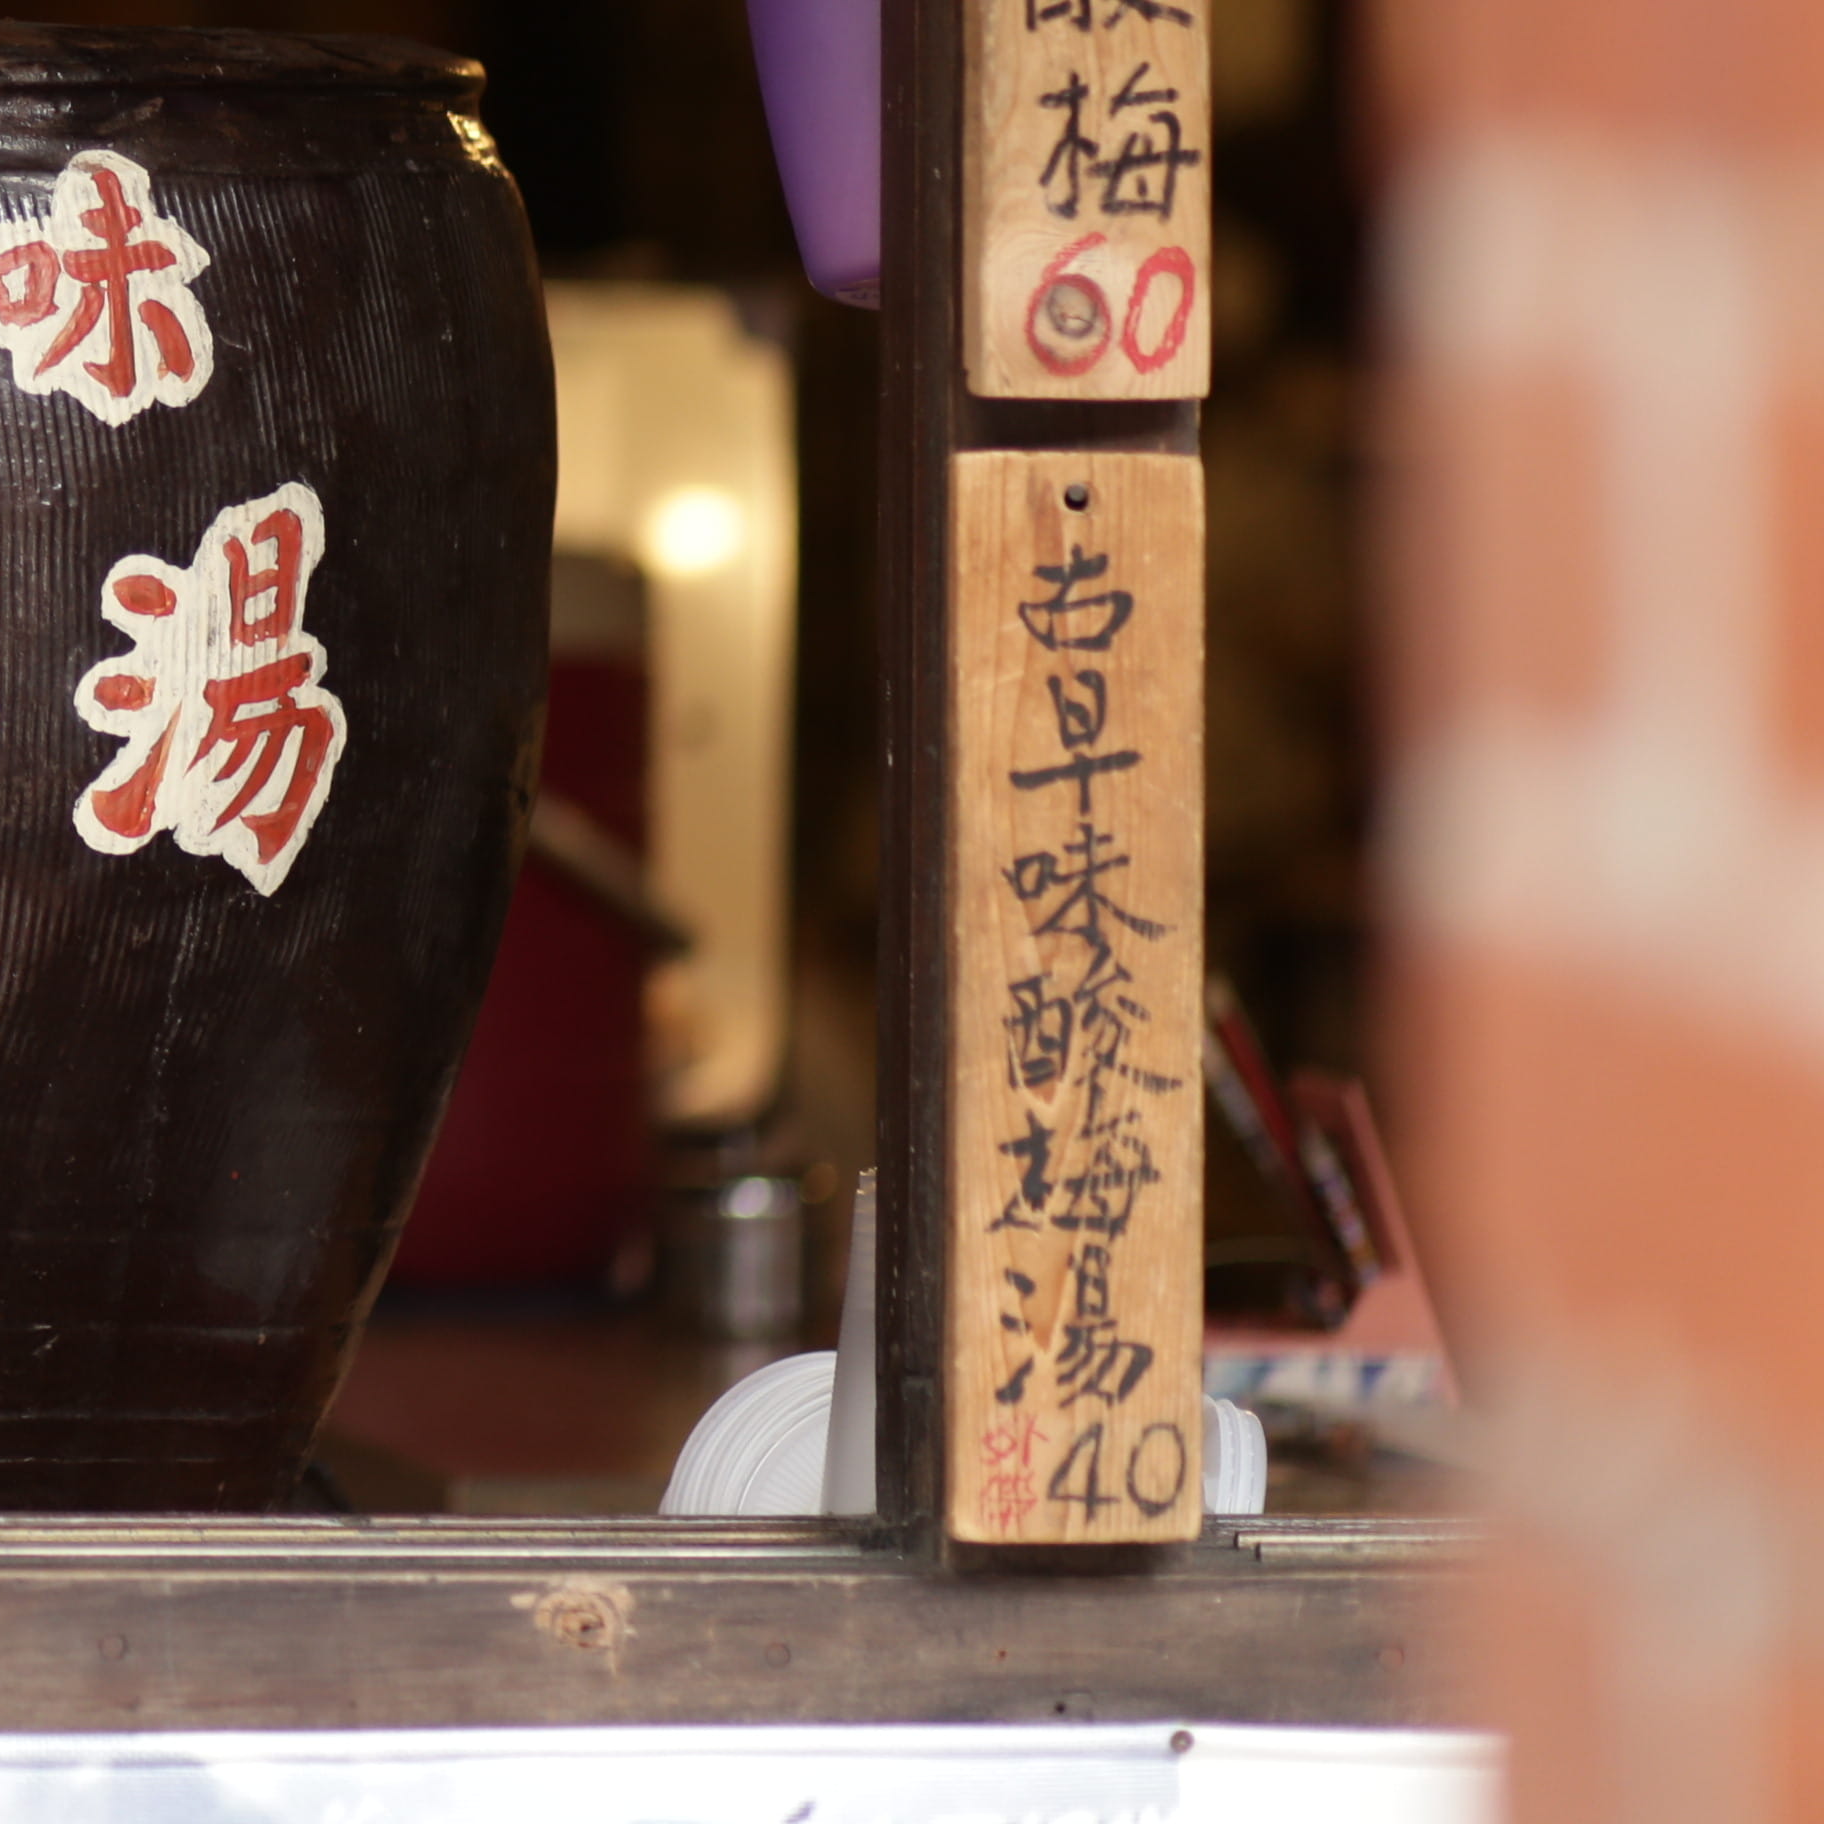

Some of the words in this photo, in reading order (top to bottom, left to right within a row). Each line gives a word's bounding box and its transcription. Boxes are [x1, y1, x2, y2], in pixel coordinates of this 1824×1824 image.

[1024, 228, 1197, 378] 60
[986, 552, 1184, 1408] 古早味酸梅湯
[1046, 1420, 1188, 1520] 40
